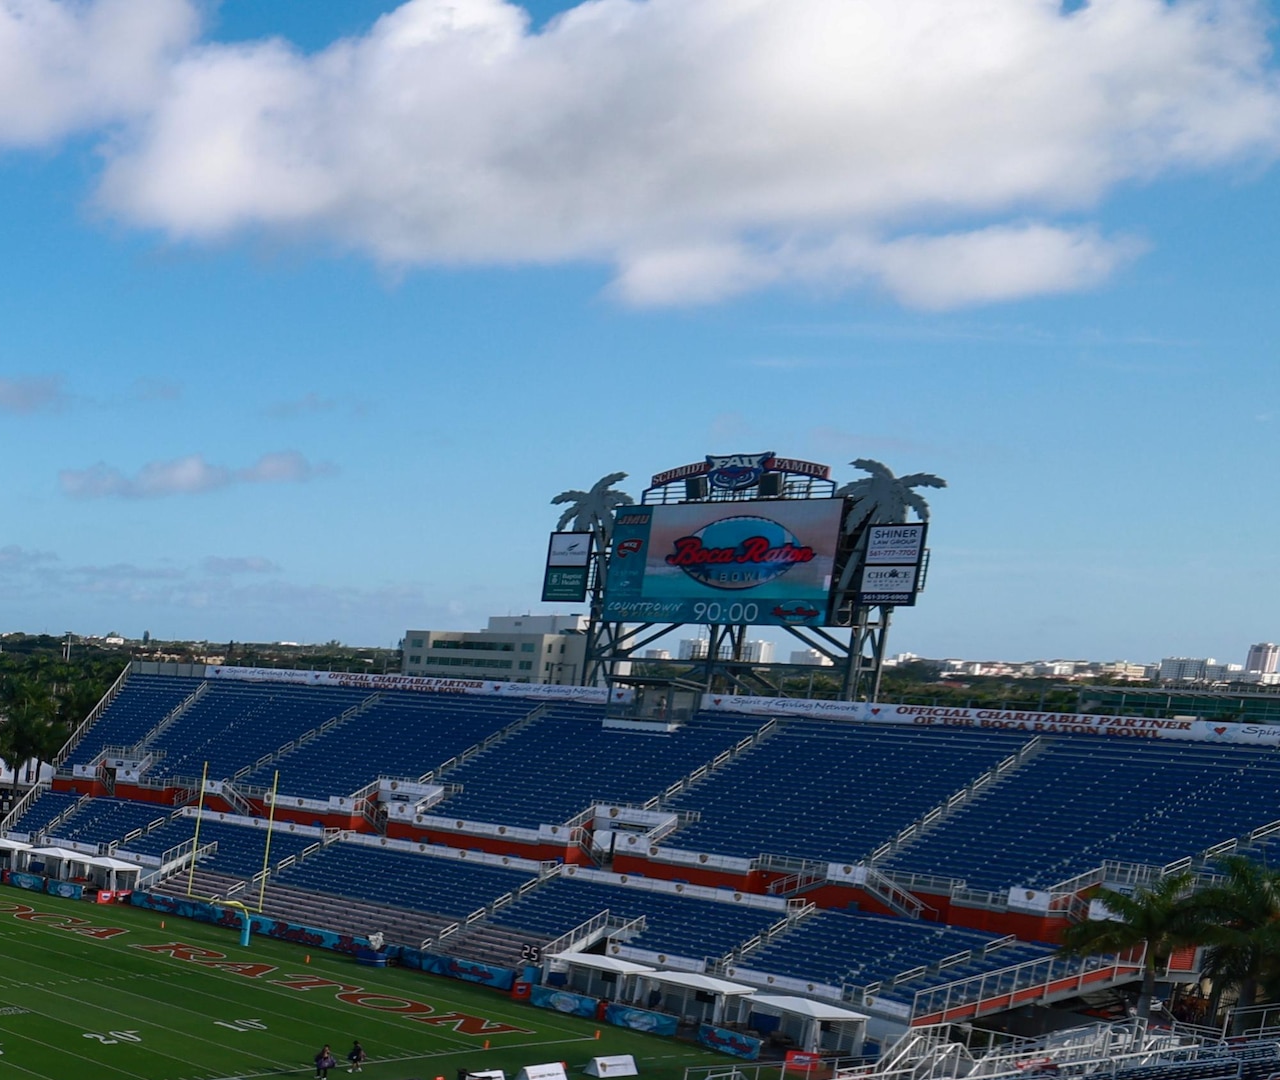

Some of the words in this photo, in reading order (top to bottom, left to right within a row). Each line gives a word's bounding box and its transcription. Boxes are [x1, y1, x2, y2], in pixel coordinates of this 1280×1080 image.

[710, 454, 764, 470] FAU
[773, 458, 829, 476] FAMILY
[652, 462, 707, 485] SCHMIDT
[618, 514, 650, 525] JMU
[874, 529, 918, 538] SHINER
[666, 536, 737, 565] Boca
[736, 537, 815, 563] Raton
[869, 549, 917, 557] 561-777-7700
[719, 571, 766, 582] BOWL
[867, 570, 911, 579] CHOICE
[607, 602, 683, 612] COUNTDOWN
[693, 602, 759, 622] 90:00
[328, 672, 370, 682] OFFICIAL
[371, 675, 433, 686] CHARITABLE
[434, 679, 483, 689] PARTNER
[730, 698, 761, 708] Spirit
[774, 699, 813, 711] Giving
[815, 702, 859, 712] Network
[896, 705, 973, 718] OFFICIAL
[976, 709, 1093, 724] CHARITABLE
[1097, 716, 1192, 731] PARTNER
[913, 715, 936, 725] OF
[940, 716, 974, 727] THE
[979, 718, 1030, 730] BOCA
[1033, 721, 1102, 734] RATON
[521, 945, 539, 961] 25
[127, 942, 537, 1036] RATON
[83, 1029, 141, 1045] 20
